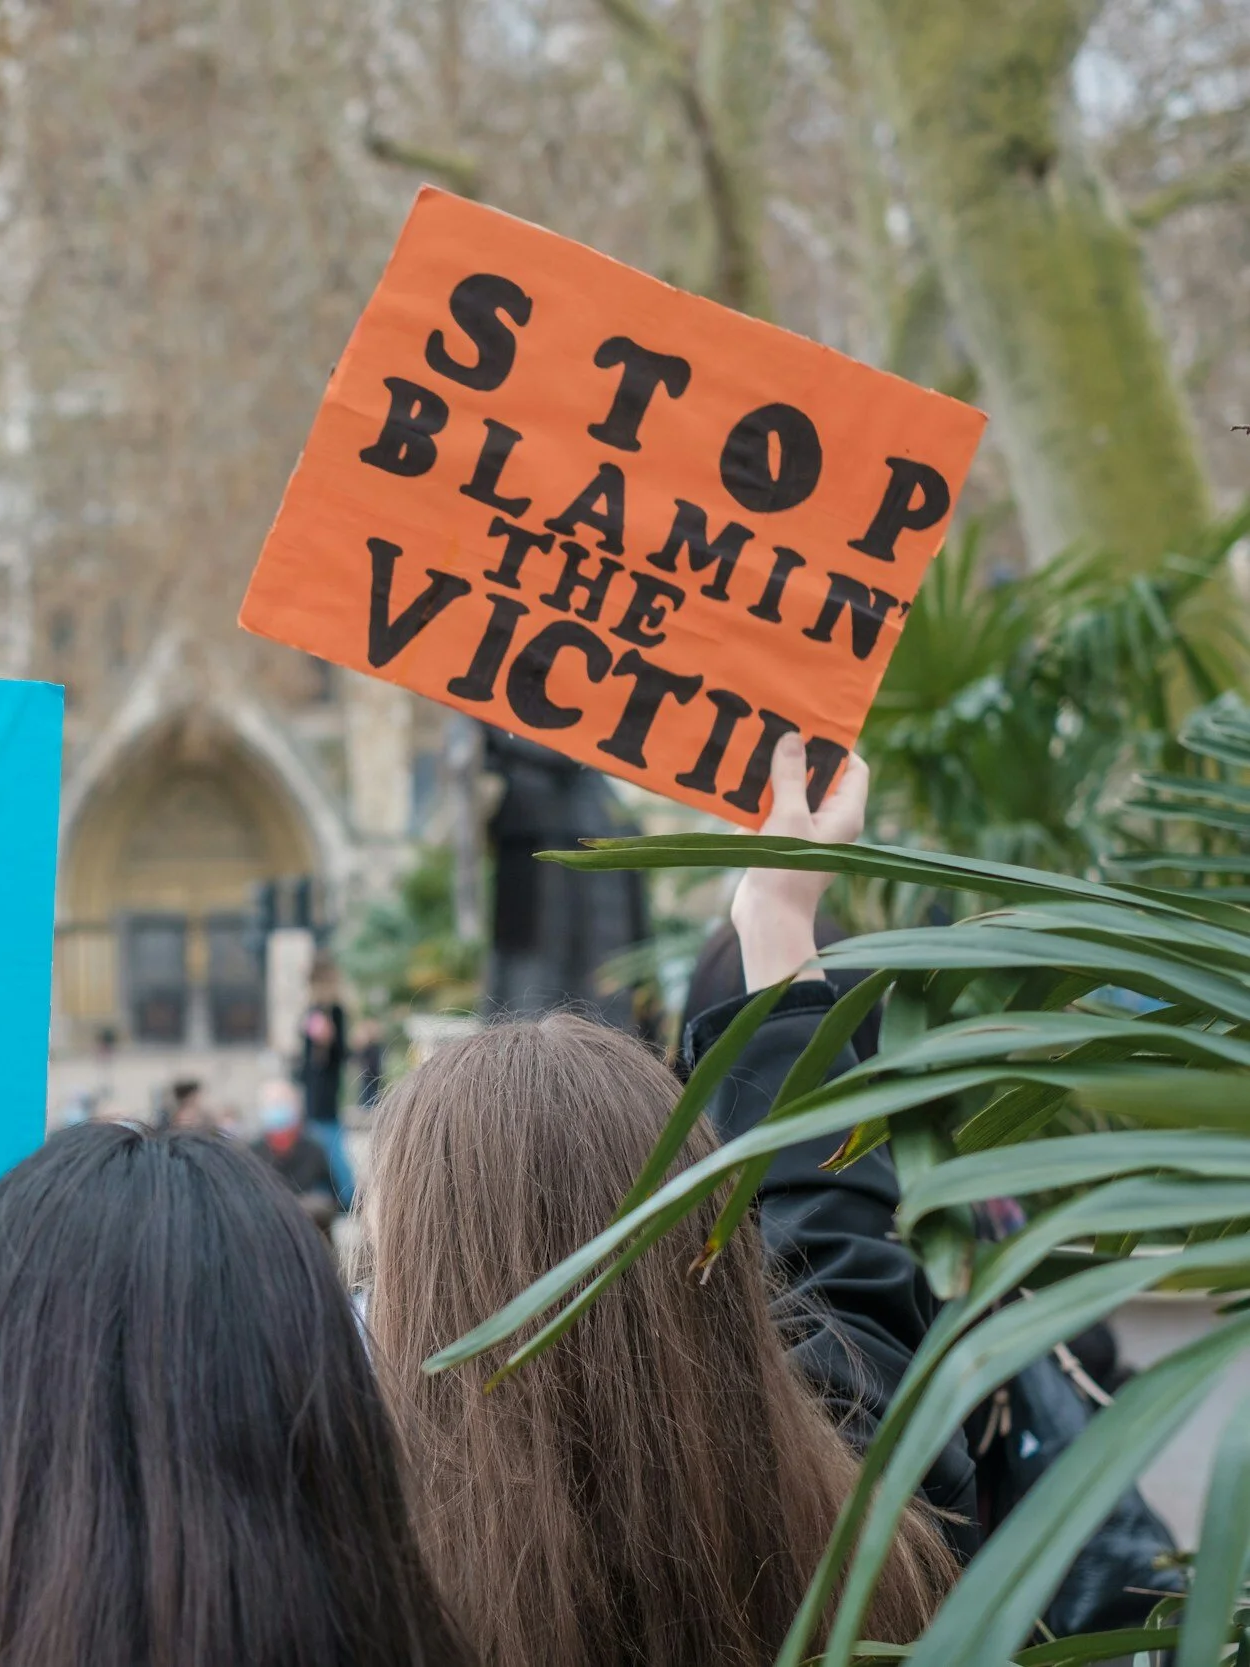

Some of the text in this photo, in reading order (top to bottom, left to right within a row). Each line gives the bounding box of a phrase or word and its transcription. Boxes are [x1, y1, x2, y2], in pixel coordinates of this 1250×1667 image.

[359, 376, 910, 661] BLAMIN'
[425, 273, 951, 562] STOP
[483, 516, 686, 648] THE
